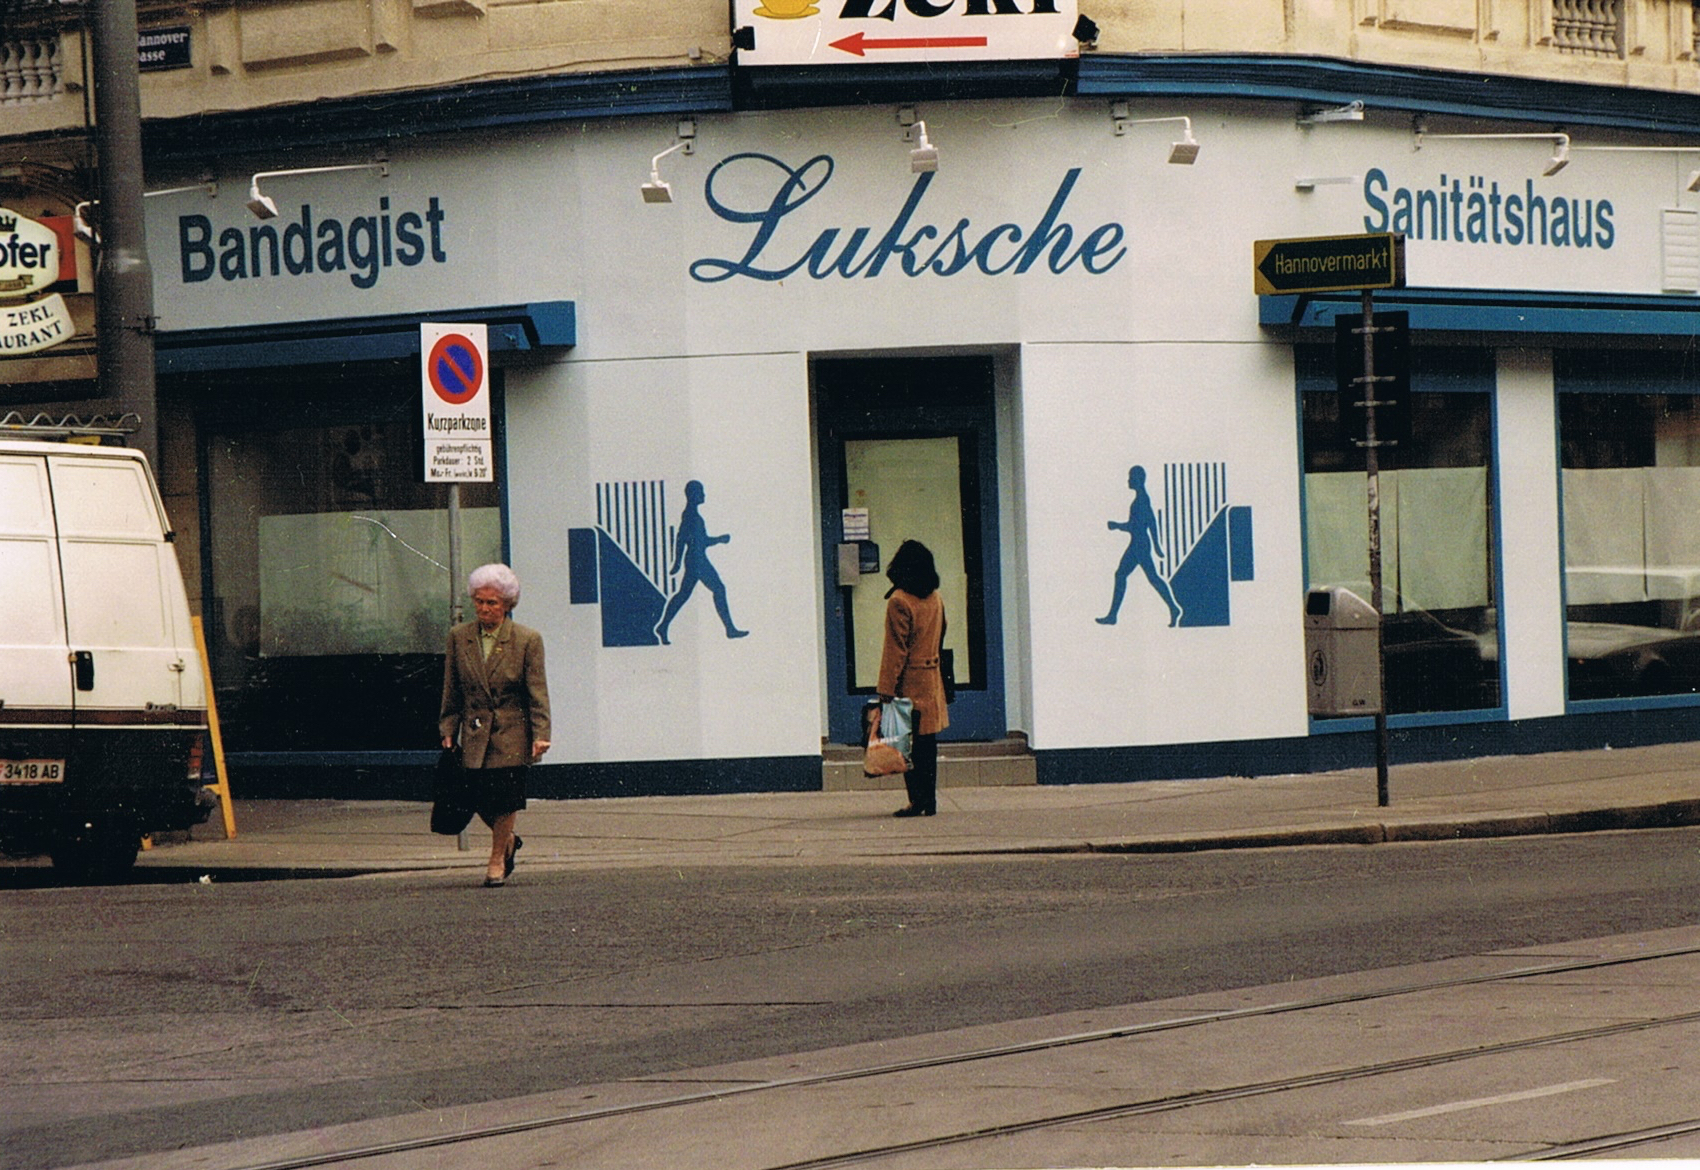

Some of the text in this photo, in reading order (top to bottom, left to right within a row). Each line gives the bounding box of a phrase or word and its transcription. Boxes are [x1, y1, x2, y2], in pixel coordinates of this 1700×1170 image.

[139, 50, 166, 62] asse
[689, 153, 1127, 283] Luksche
[1364, 168, 1615, 250] Sanitätshaus
[179, 196, 447, 289] Bandagist
[1275, 247, 1389, 275] Hannovermarkt
[0, 320, 62, 349] URANT
[427, 412, 487, 434] Kurzparkzone
[4, 763, 59, 779] 3418 AB
